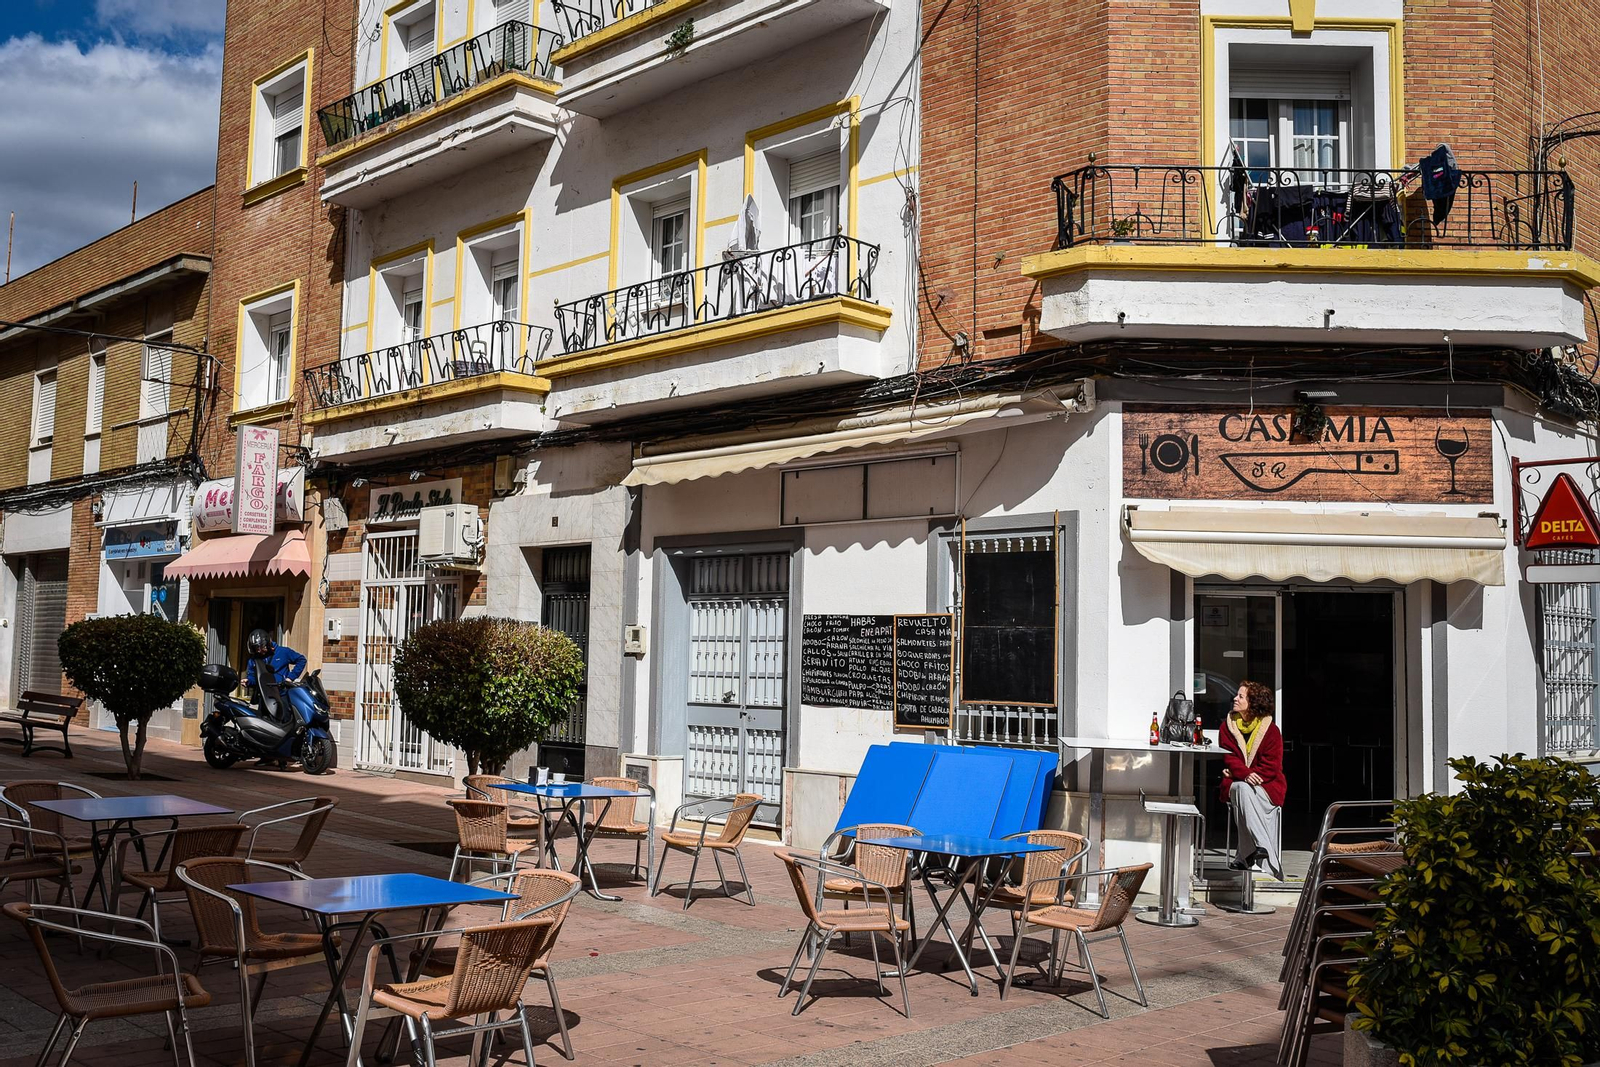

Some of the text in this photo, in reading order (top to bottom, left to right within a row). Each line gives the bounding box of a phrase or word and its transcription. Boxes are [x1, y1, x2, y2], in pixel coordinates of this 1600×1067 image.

[1219, 413, 1395, 442] CAS MIA
[250, 452, 266, 510] FARGO
[1541, 520, 1585, 533] DELTA
[850, 616, 876, 627] HABAS
[898, 616, 947, 627] REVUELTO
[896, 659, 920, 668] CHOCO
[848, 671, 891, 684] CROQUETAS
[848, 681, 866, 690] PULPO
[897, 680, 920, 691] ADOBO
[920, 705, 926, 713] DE
